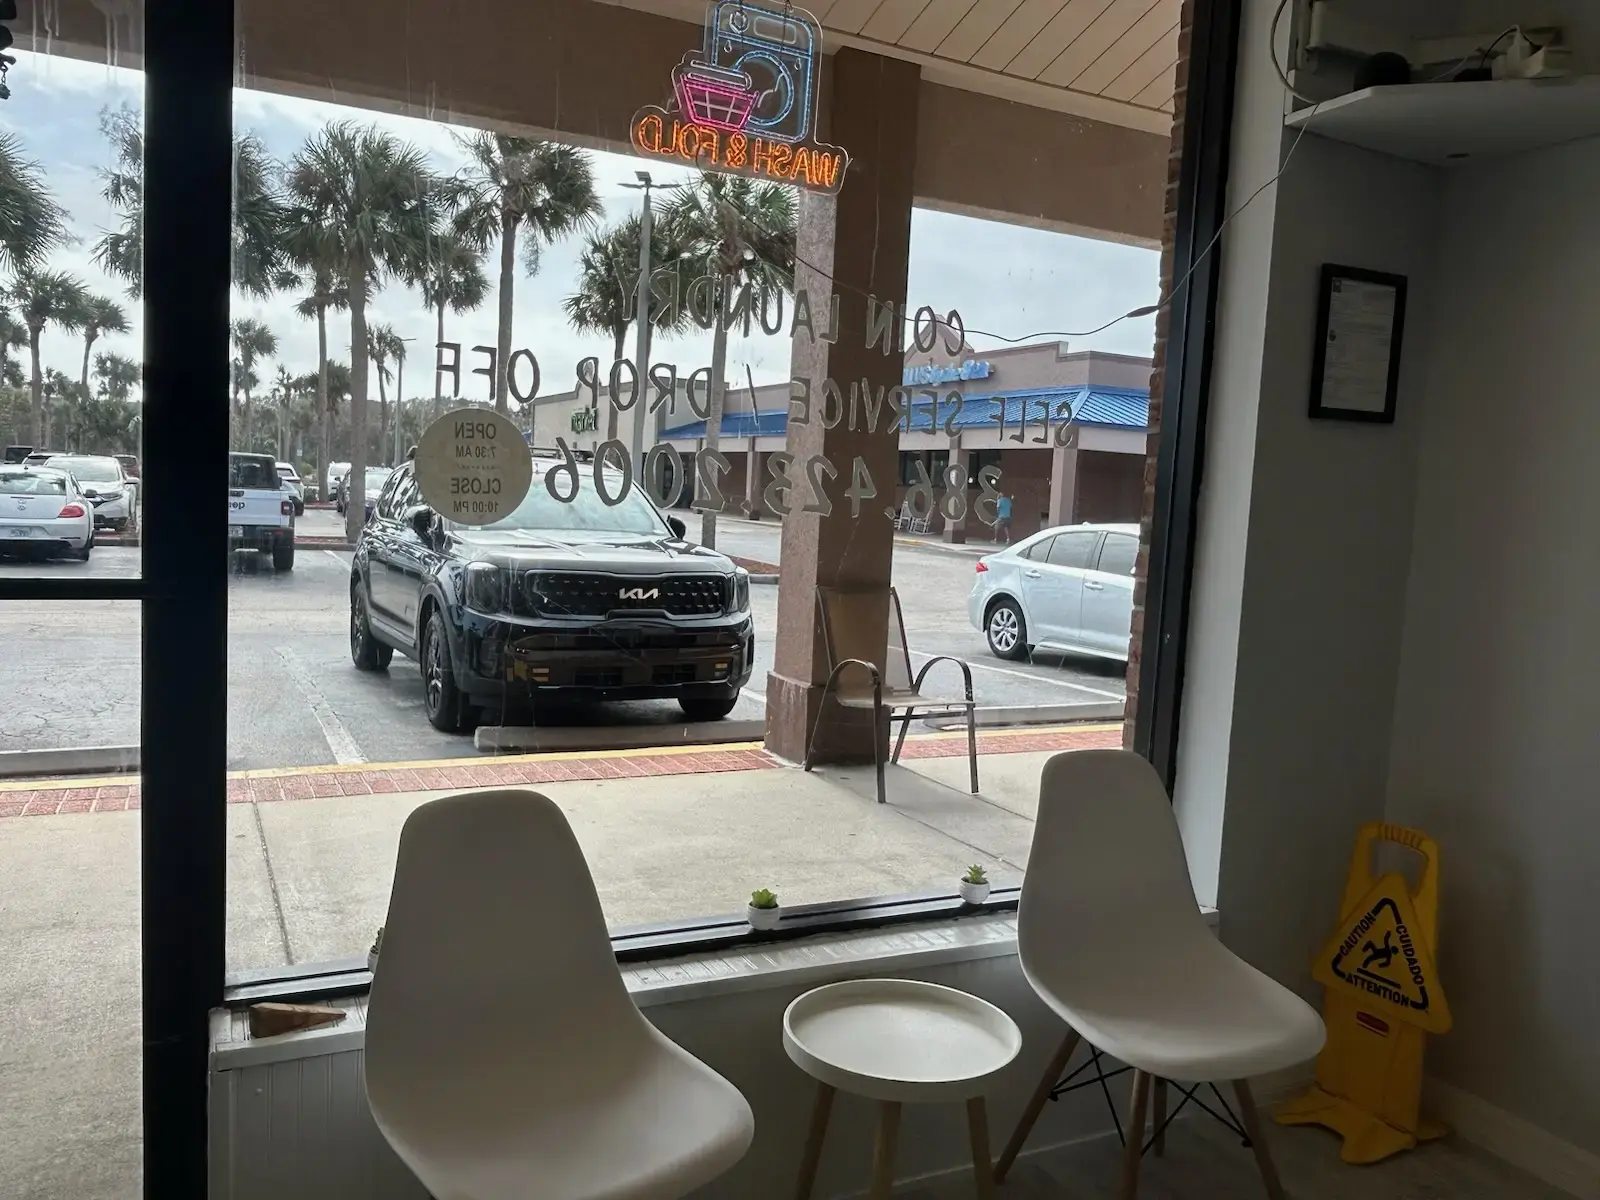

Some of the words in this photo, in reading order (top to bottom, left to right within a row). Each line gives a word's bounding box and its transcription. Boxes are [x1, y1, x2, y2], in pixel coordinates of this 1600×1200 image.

[618, 587, 659, 600] KIA
[1339, 911, 1377, 957] CAUTION
[1396, 924, 1425, 986] CUIDADO
[1345, 973, 1411, 1007] ATTENTION
